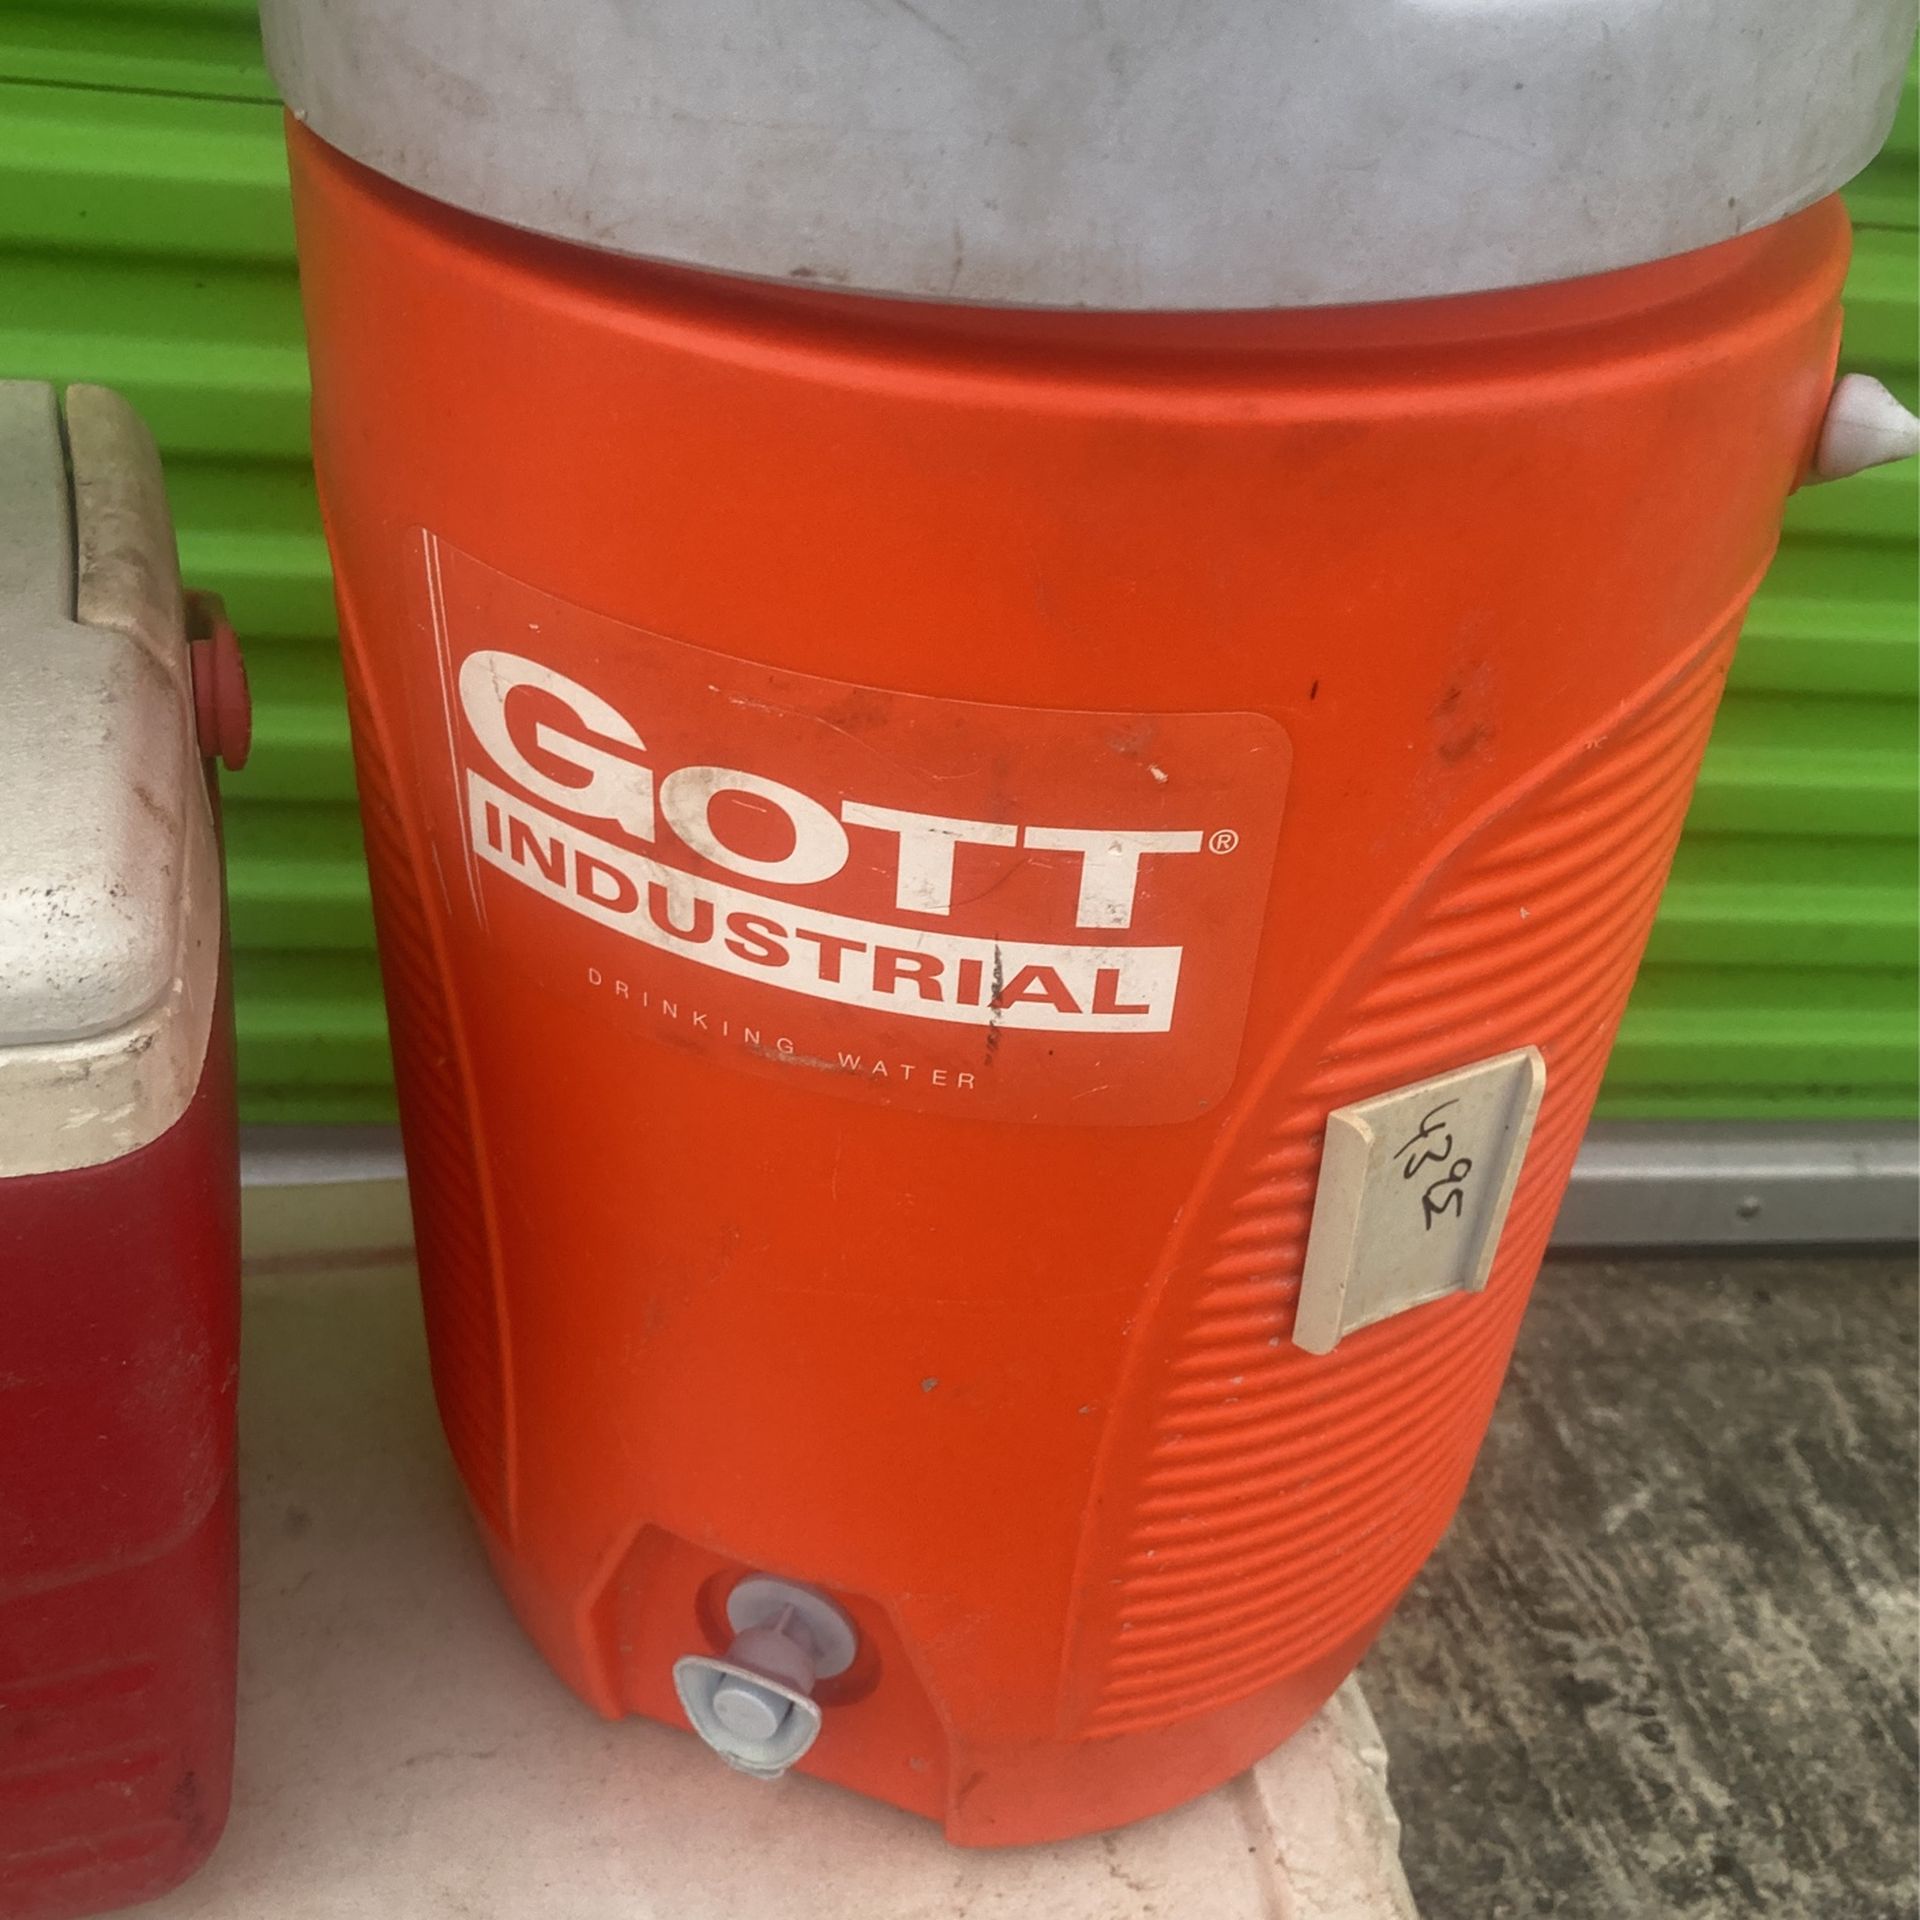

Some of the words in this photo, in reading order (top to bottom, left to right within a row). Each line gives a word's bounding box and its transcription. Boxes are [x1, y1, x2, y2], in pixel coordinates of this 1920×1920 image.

[459, 650, 1204, 929] GOTT
[485, 800, 1150, 1014] INDUSTRIAL
[588, 967, 794, 1054] DRINKING
[837, 1051, 975, 1089] WATER
